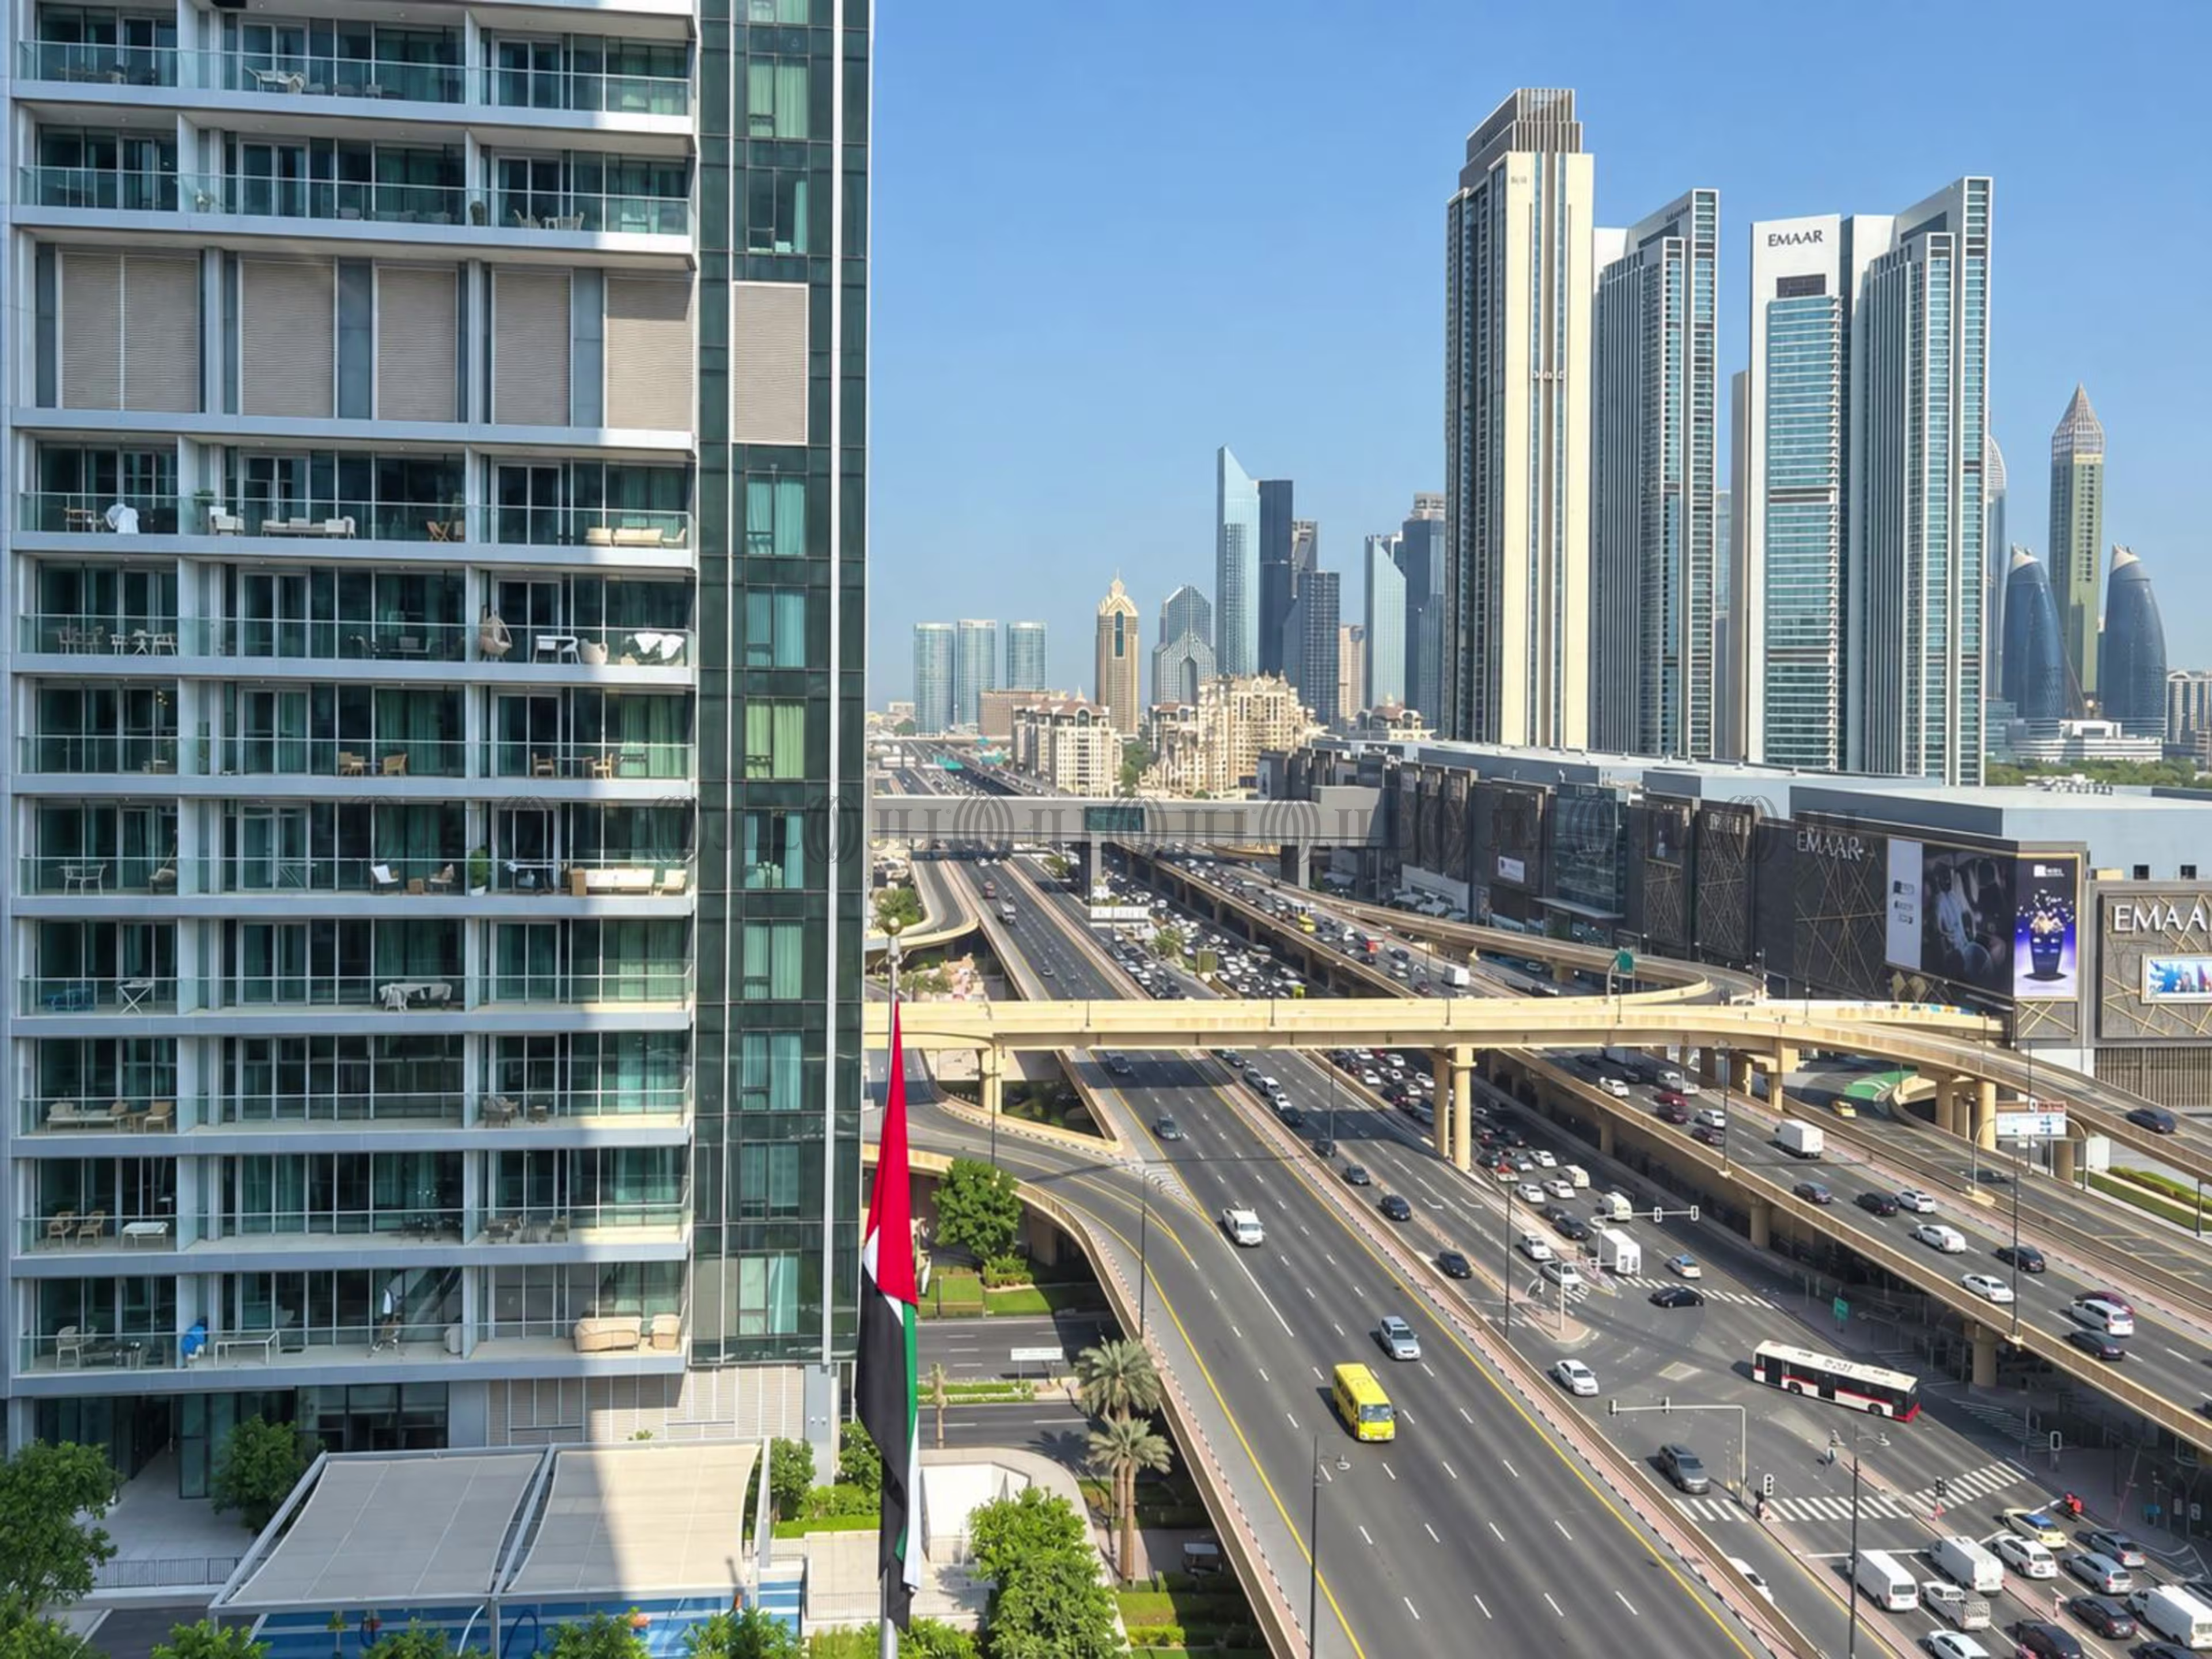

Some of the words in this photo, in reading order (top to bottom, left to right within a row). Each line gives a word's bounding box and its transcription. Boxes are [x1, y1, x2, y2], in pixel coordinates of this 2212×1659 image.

[1768, 229, 1823, 247] EMAAR
[1797, 830, 1861, 861] EMAAR
[2114, 905, 2212, 931] EMAA
